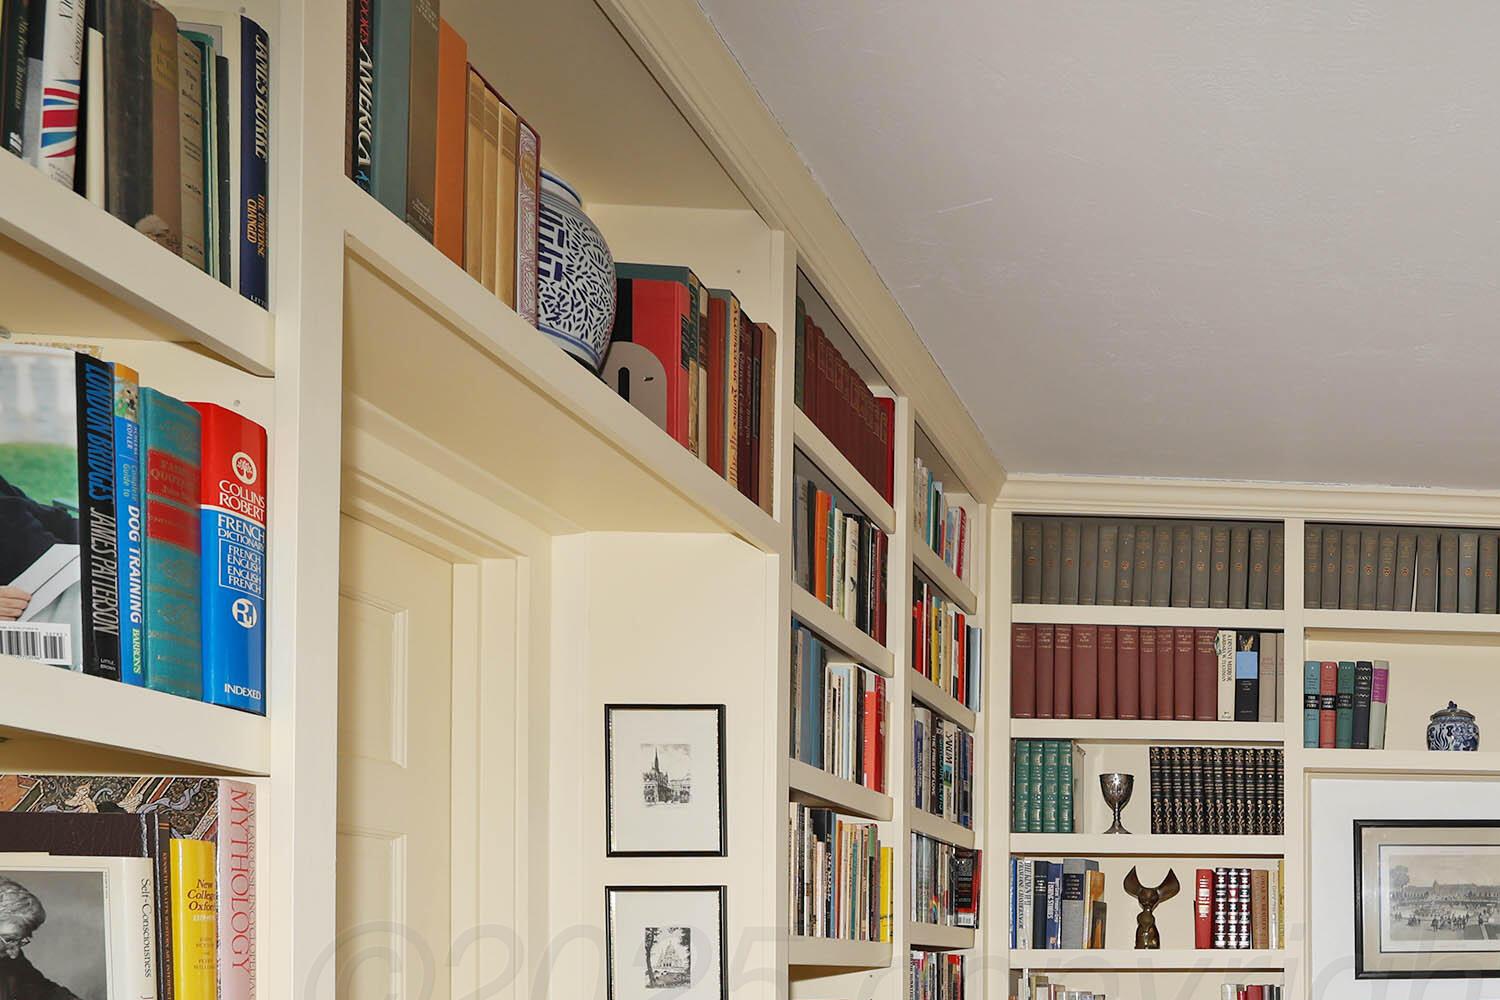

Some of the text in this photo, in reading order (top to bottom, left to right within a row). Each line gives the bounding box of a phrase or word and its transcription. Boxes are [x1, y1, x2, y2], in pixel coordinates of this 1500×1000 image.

[254, 34, 269, 161] JAMES BURKE
[358, 43, 374, 166] AMERICA
[246, 198, 257, 244] CHANGED
[256, 213, 266, 257] UNIVERSE
[122, 464, 131, 498] Guide to
[218, 480, 265, 509] COLLINS
[85, 362, 119, 637] LONDON BRIDGES JAMES PATTERSON
[218, 492, 265, 521] ROBERT
[218, 513, 265, 540] FRENCH
[218, 528, 265, 551] DICTIONARY
[127, 504, 142, 624] DOG TRAINING
[227, 556, 261, 575] ENGLISH
[228, 544, 261, 564] FRENCH
[227, 566, 261, 586] ENGLISH
[228, 576, 261, 595] FRENCH
[223, 683, 261, 701] INDEXED
[196, 879, 214, 891] New
[231, 788, 250, 974] MYTHOLOGY
[140, 878, 153, 979] Self-Consciousness
